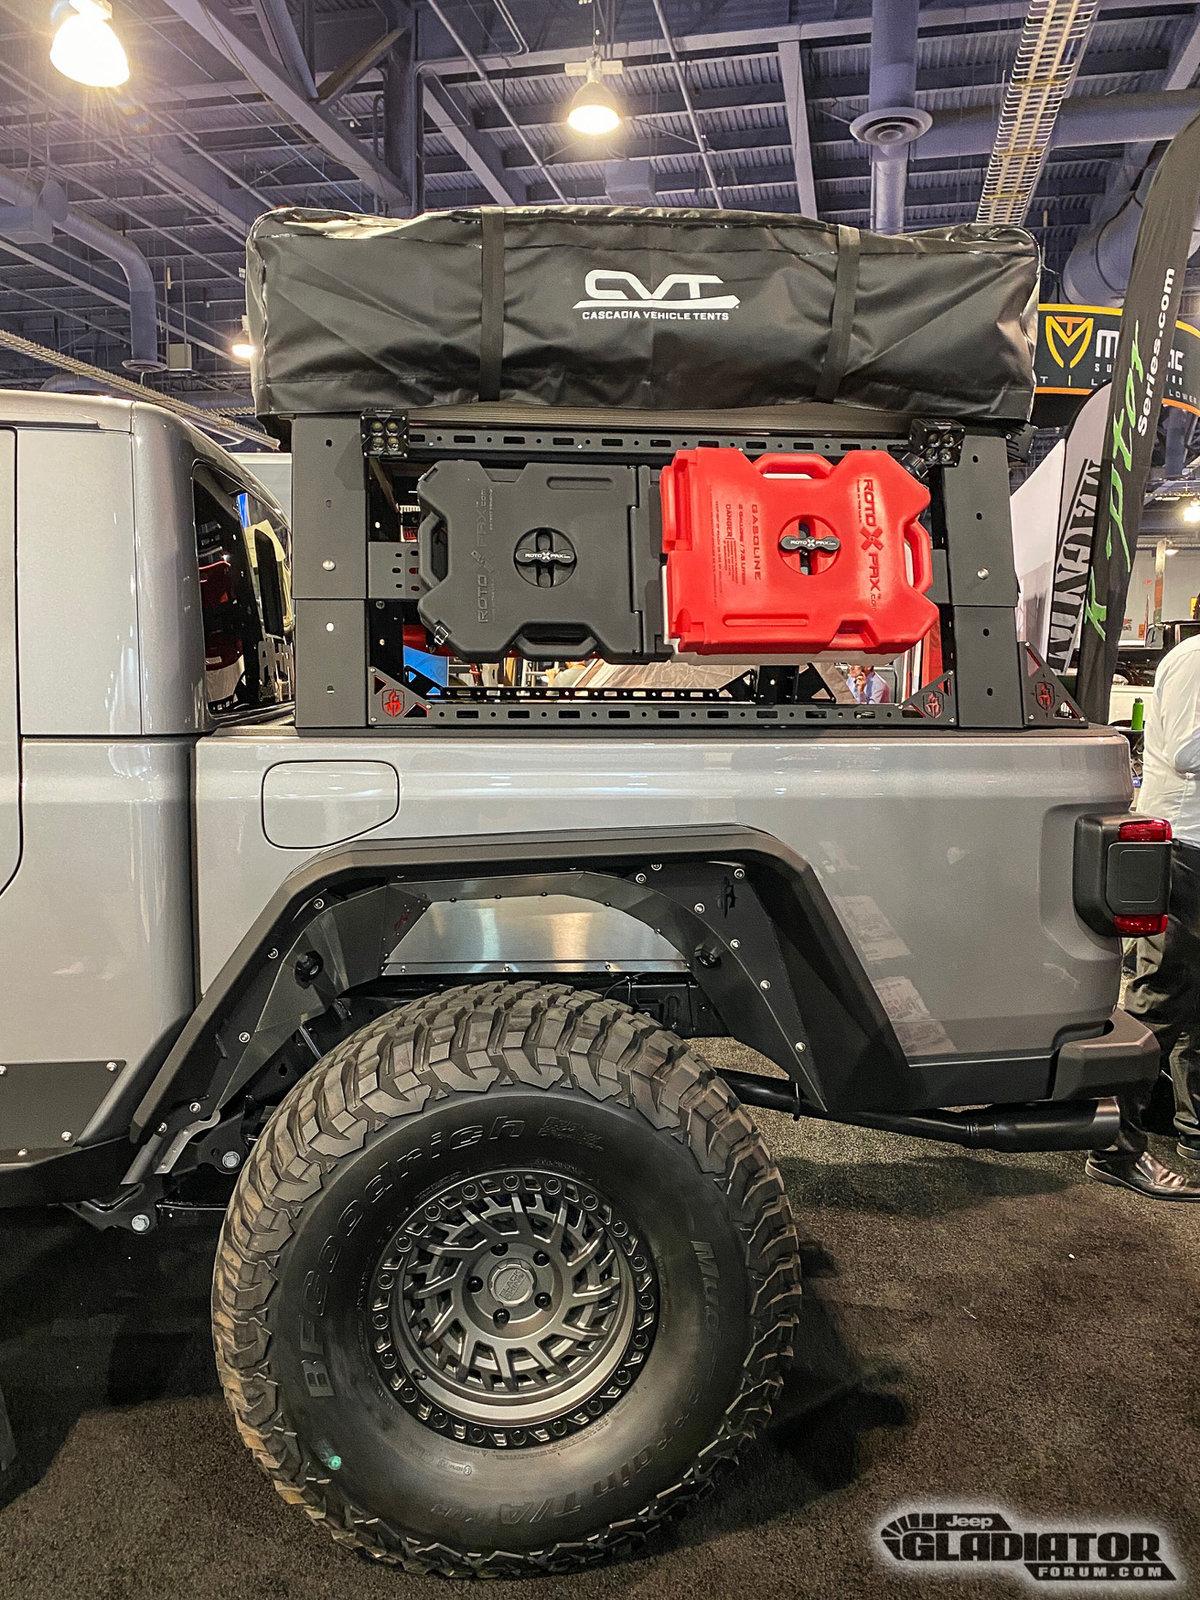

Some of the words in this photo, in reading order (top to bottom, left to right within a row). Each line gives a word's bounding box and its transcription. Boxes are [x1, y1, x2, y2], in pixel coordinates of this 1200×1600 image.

[582, 310, 641, 320] CASCADIA
[642, 311, 691, 320] VEHICLE
[694, 312, 729, 321] TENTS
[1137, 268, 1176, 437] Series.com
[725, 504, 733, 538] DANGER
[751, 504, 762, 581] GASOLINE
